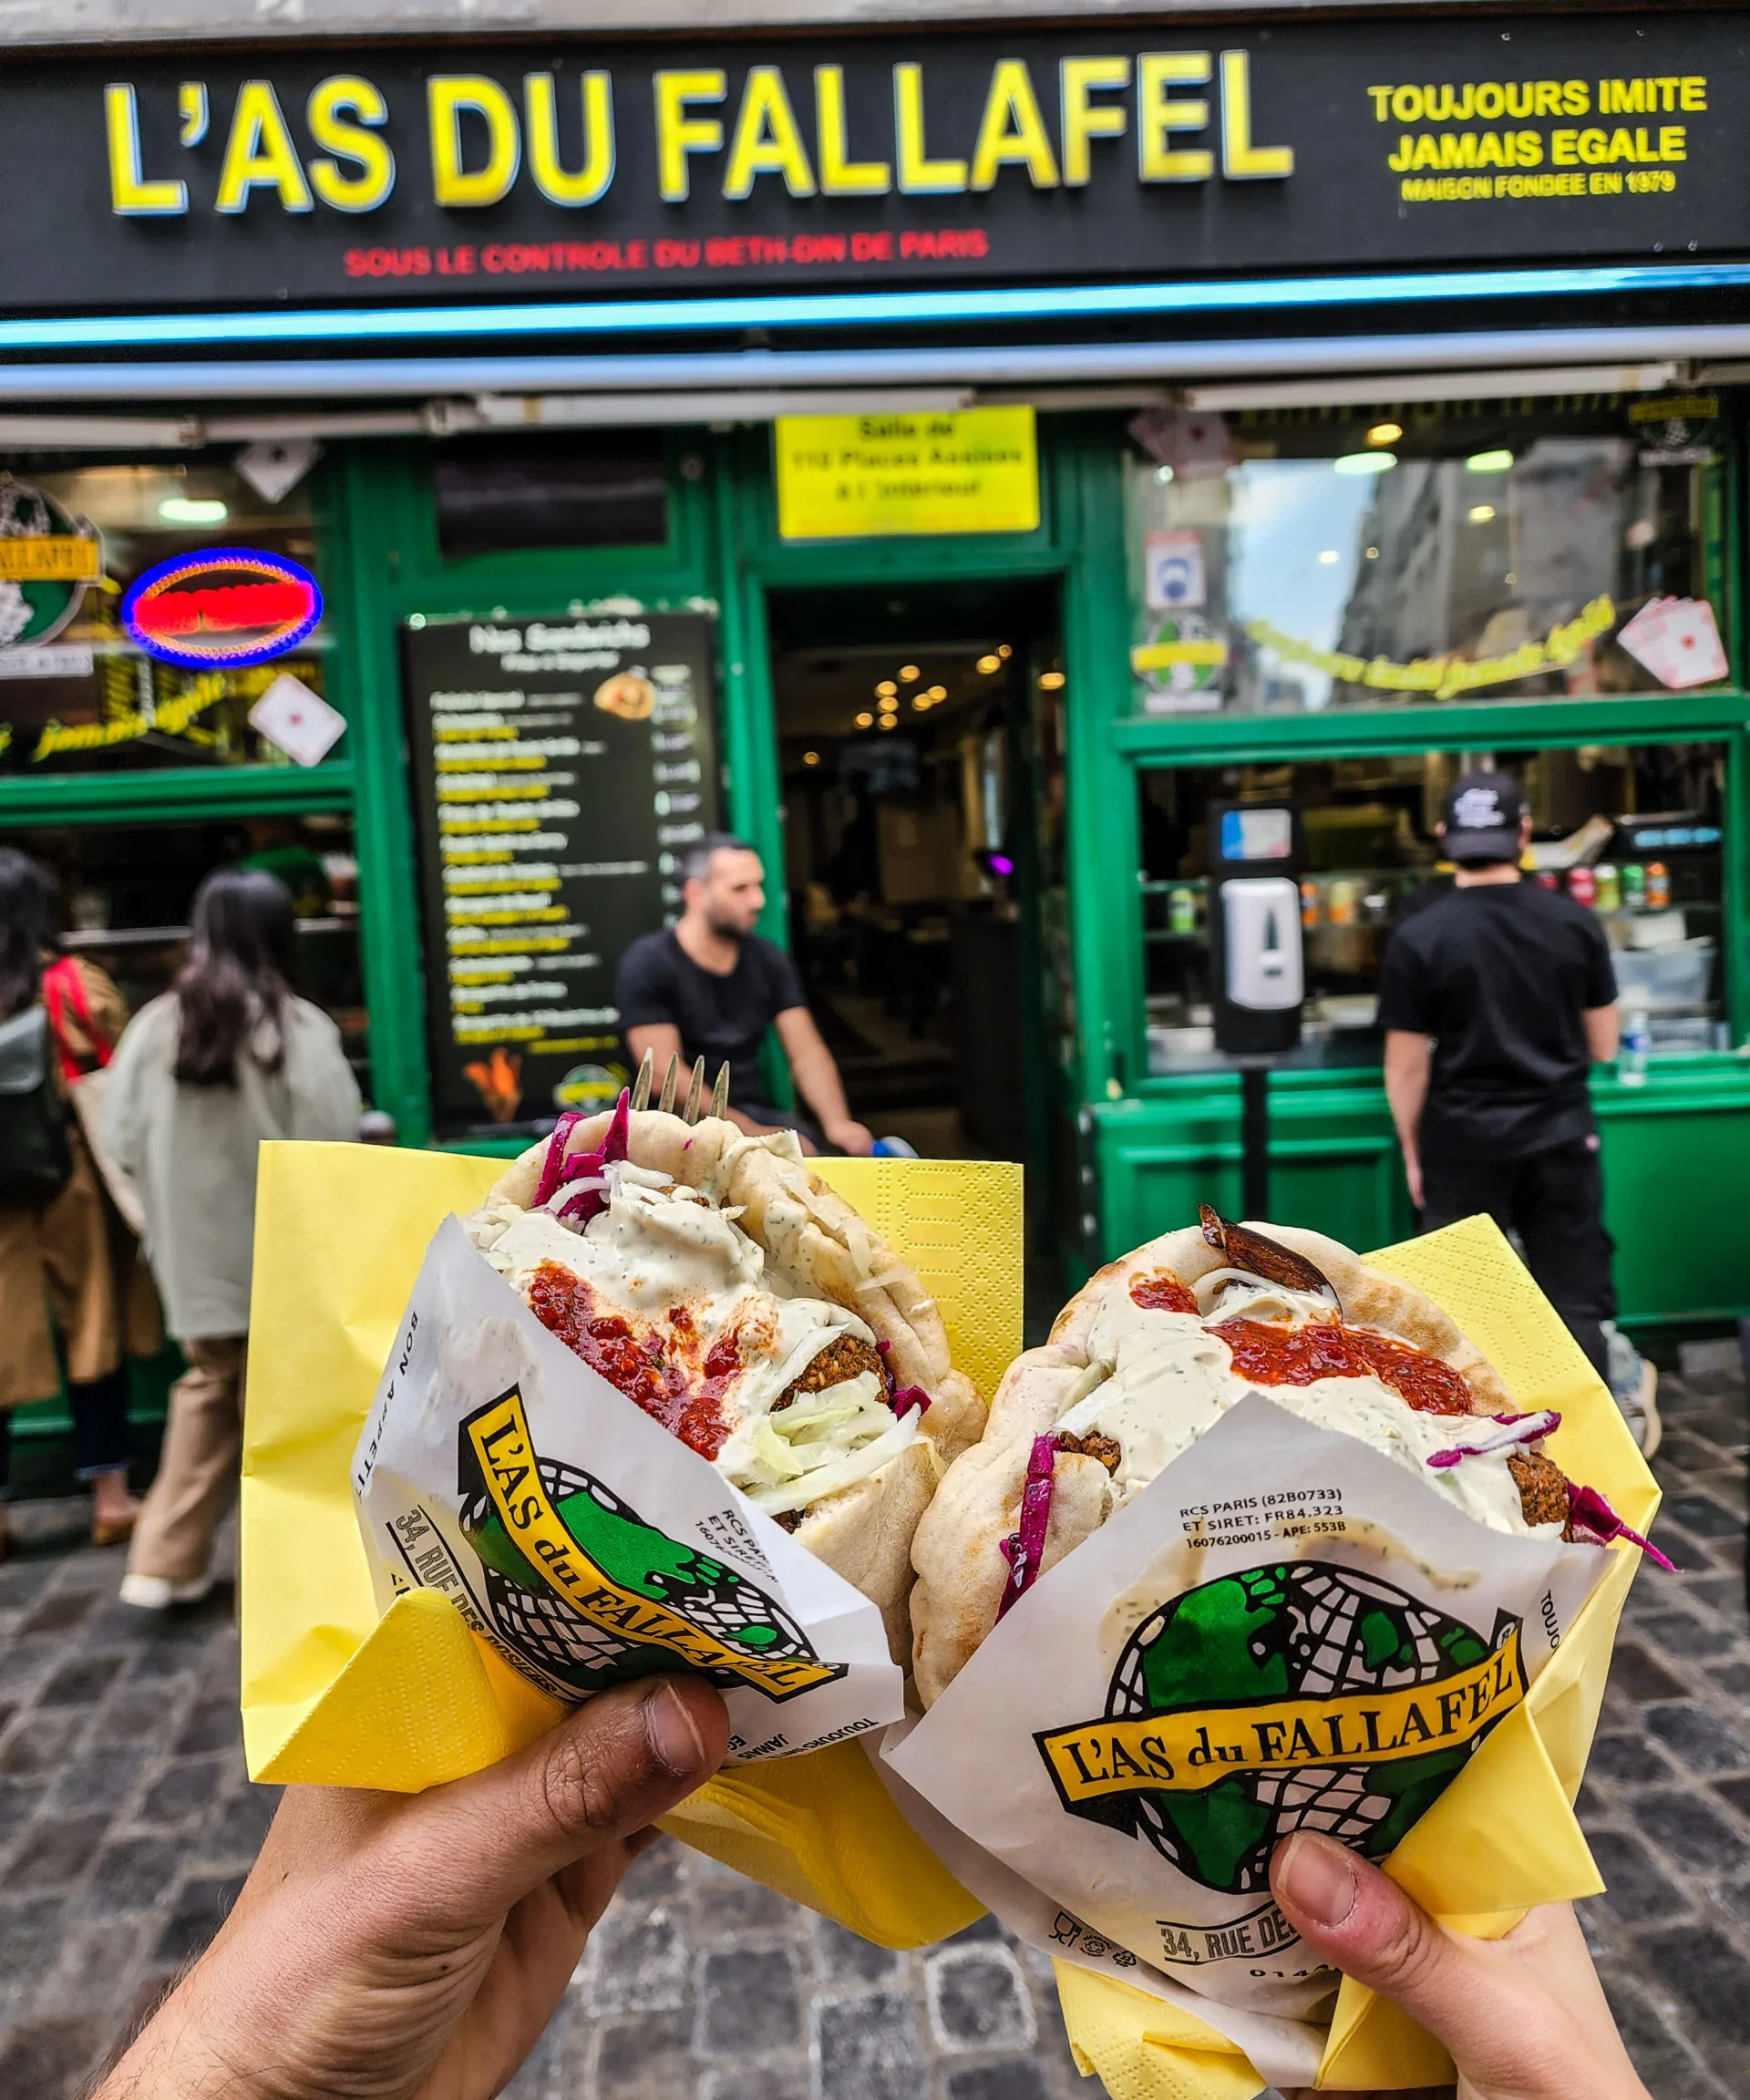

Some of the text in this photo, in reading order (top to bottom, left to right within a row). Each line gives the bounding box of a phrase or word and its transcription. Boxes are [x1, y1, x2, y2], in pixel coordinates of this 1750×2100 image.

[1367, 76, 1707, 122] TOUJOURS IMITE
[104, 49, 1294, 215] L'AS DU FALLAFEL
[1388, 126, 1686, 171] JAMAIS EGALE
[1401, 170, 1676, 201] MAISON FONDEE EN 1979
[344, 245, 432, 276] SOUS
[437, 245, 477, 274] LE
[481, 240, 646, 273] CONTROLE
[654, 239, 699, 268] DU
[851, 232, 893, 262] DE
[900, 229, 989, 260] PARIS
[399, 1311, 418, 1376] BON
[479, 1415, 543, 1529] L'AS
[534, 1539, 583, 1589] du
[708, 1515, 727, 1531] ET
[722, 1509, 747, 1536] RCS
[1180, 1488, 1342, 1518] RCS PARIS (82B0733)
[1182, 1506, 1343, 1531] ET SIRET: FR84.323
[396, 1509, 430, 1551] 34,
[415, 1545, 458, 1592] RUE
[1186, 1530, 1271, 1549] 16076200015
[1282, 1526, 1311, 1539] APE:
[1313, 1521, 1346, 1533] 553B
[1540, 1589, 1560, 1651] TOUJO
[1063, 1652, 1514, 1785] L'AS du FALLAFEL
[737, 1734, 789, 1759] JAMAIS
[1160, 1928, 1199, 1961] 34,
[1204, 1926, 1255, 1959] RUE
